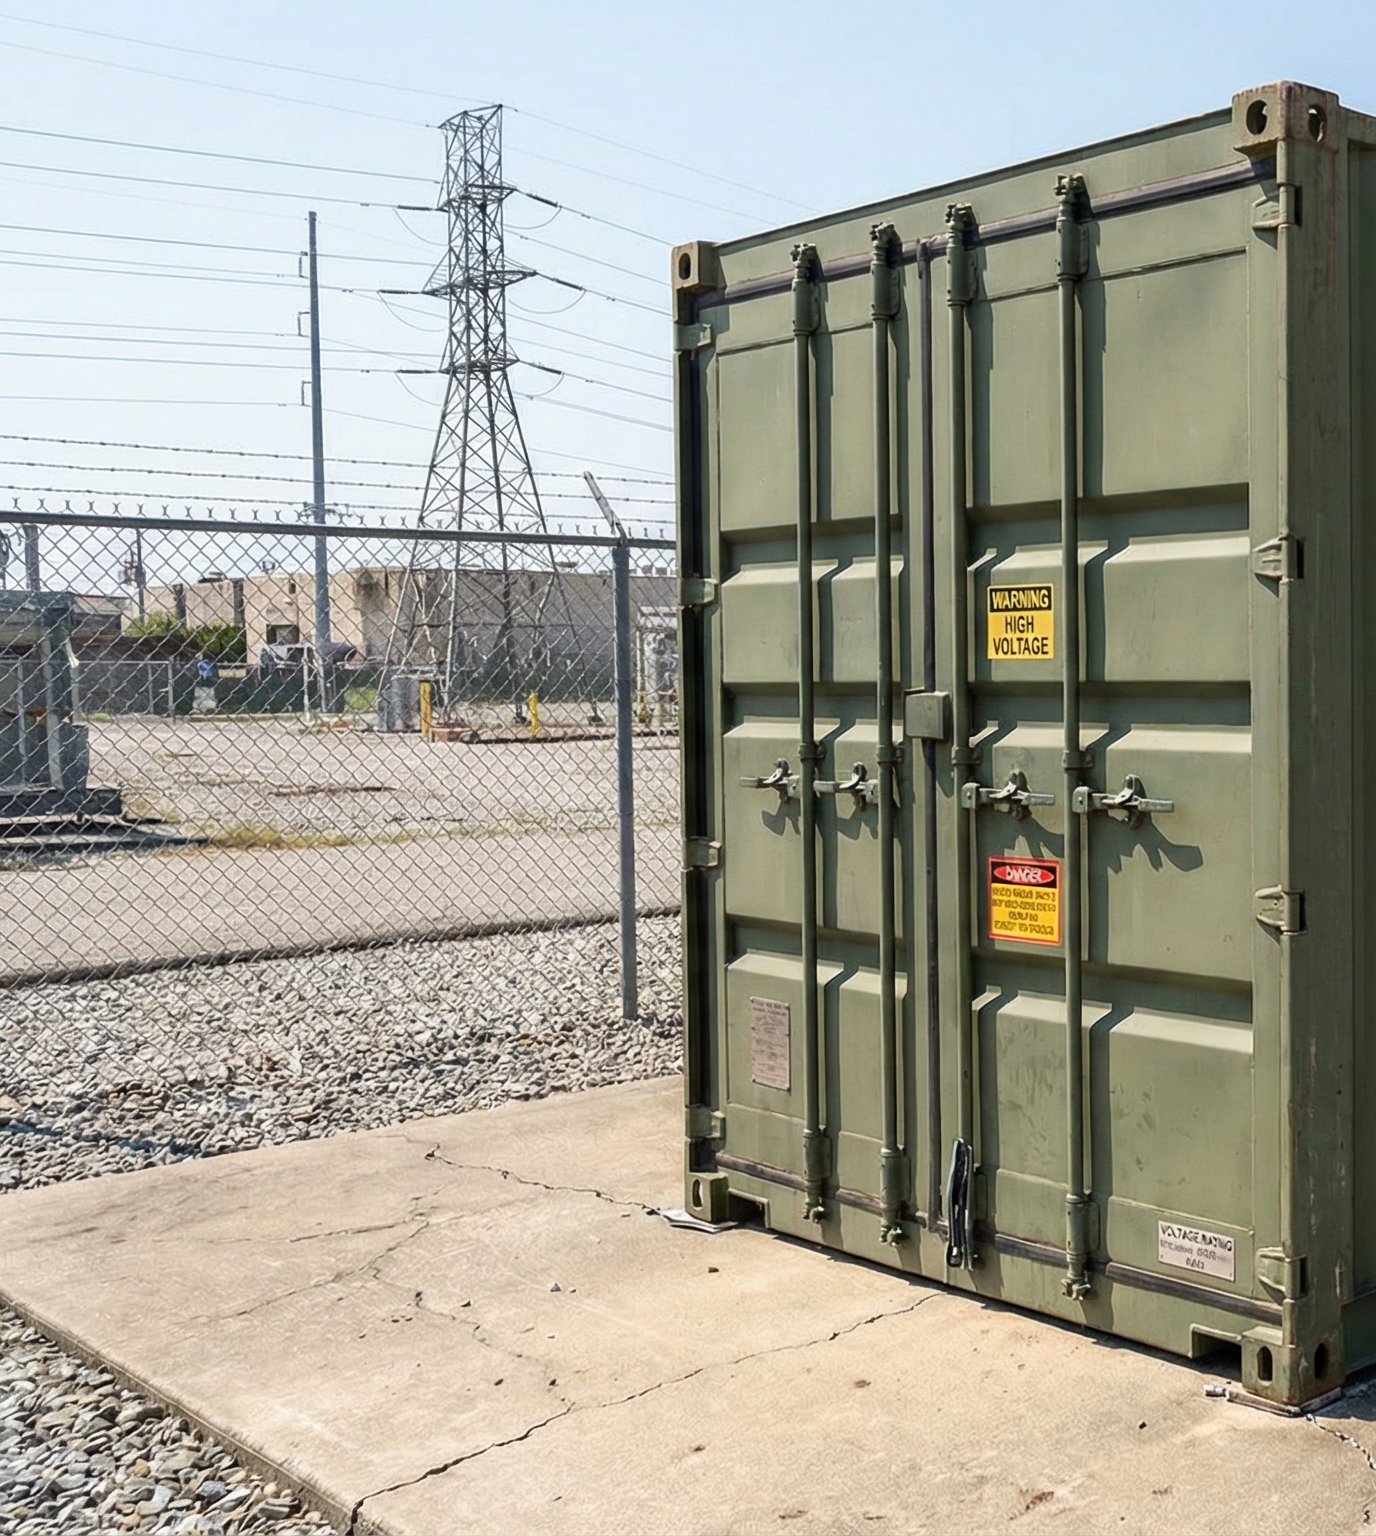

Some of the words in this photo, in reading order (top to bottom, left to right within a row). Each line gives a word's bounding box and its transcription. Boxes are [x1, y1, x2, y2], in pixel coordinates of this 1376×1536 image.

[992, 589, 1049, 609] WARNING
[1005, 616, 1034, 634] HIGH
[993, 637, 1049, 655] VOLTAGE
